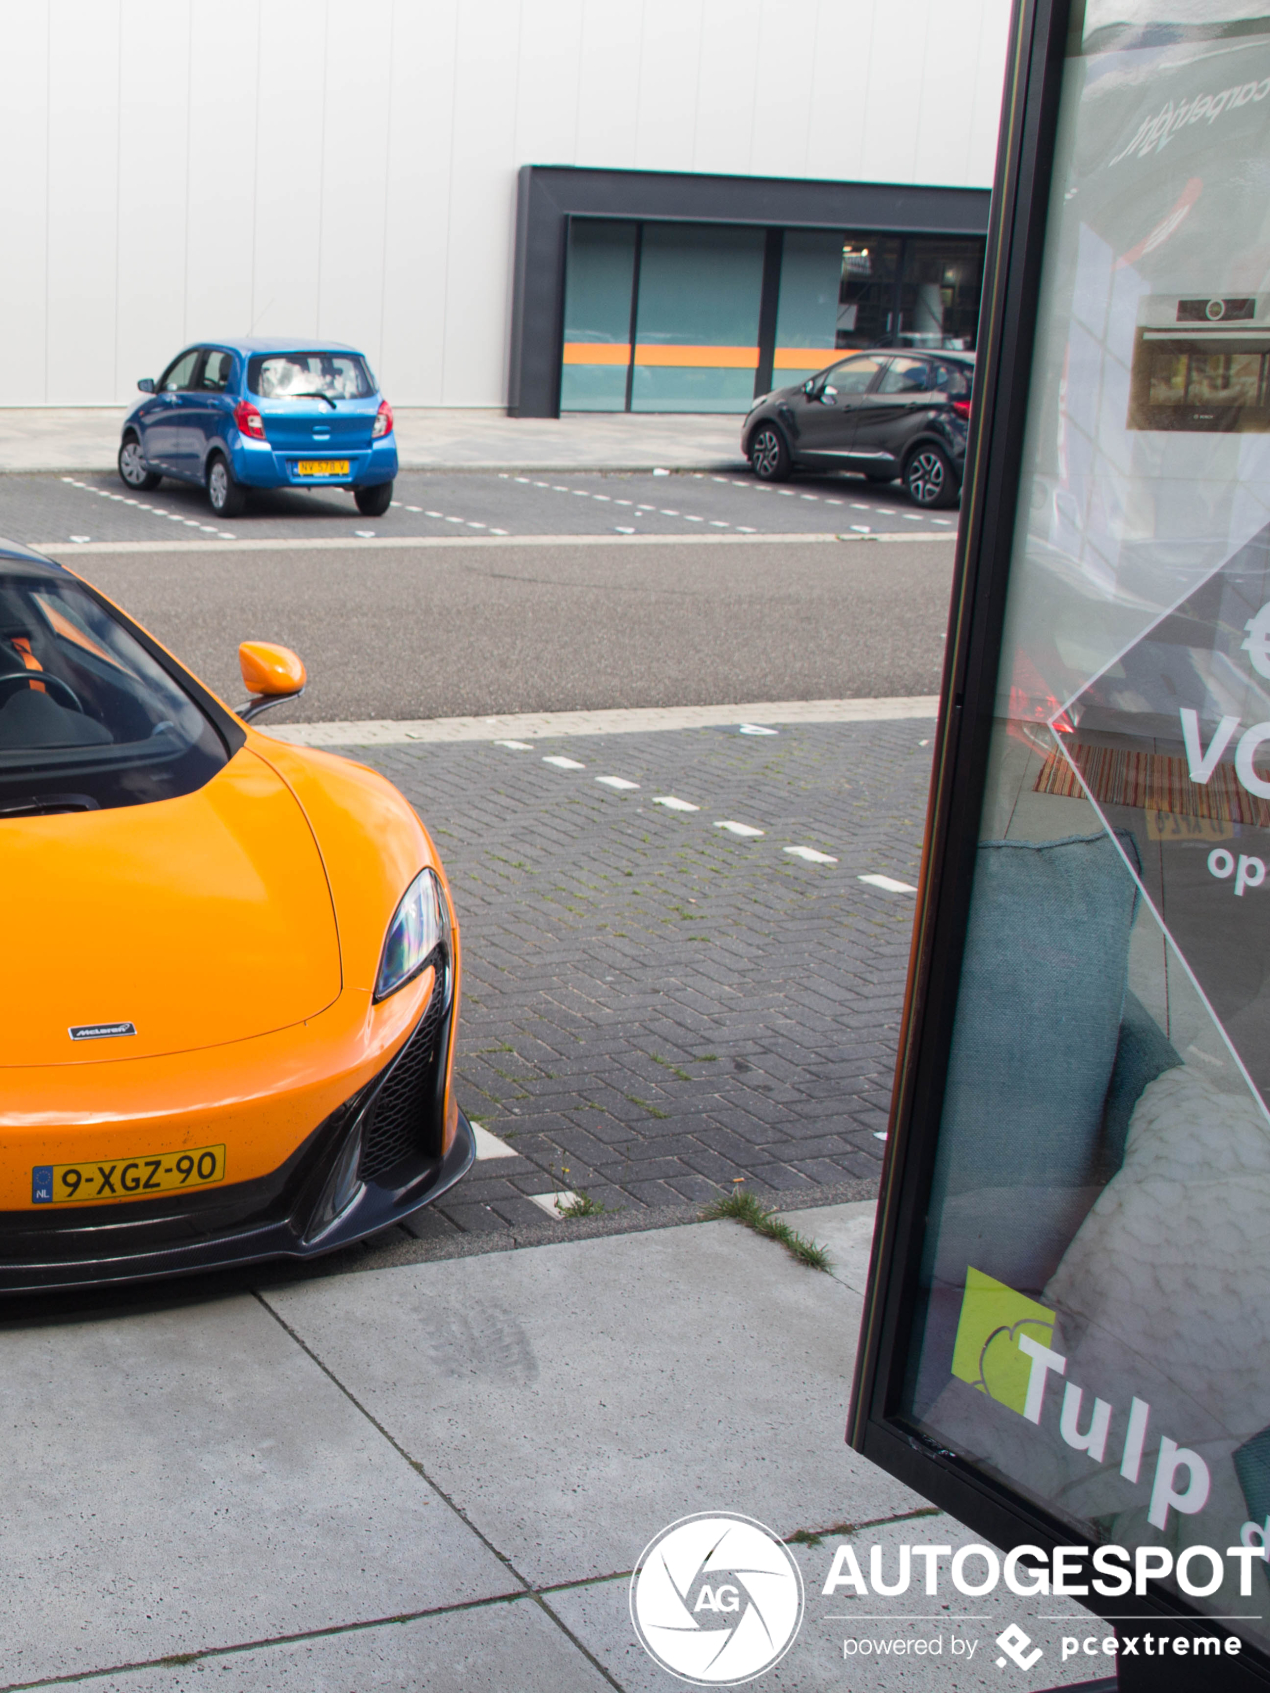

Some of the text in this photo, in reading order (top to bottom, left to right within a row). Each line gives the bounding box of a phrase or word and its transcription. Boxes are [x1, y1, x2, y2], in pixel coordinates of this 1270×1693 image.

[1207, 848, 1266, 896] op
[75, 1023, 131, 1036] McLaren
[36, 1151, 216, 1198] NL 9-XGZ-90
[1018, 1333, 1210, 1531] Tulp
